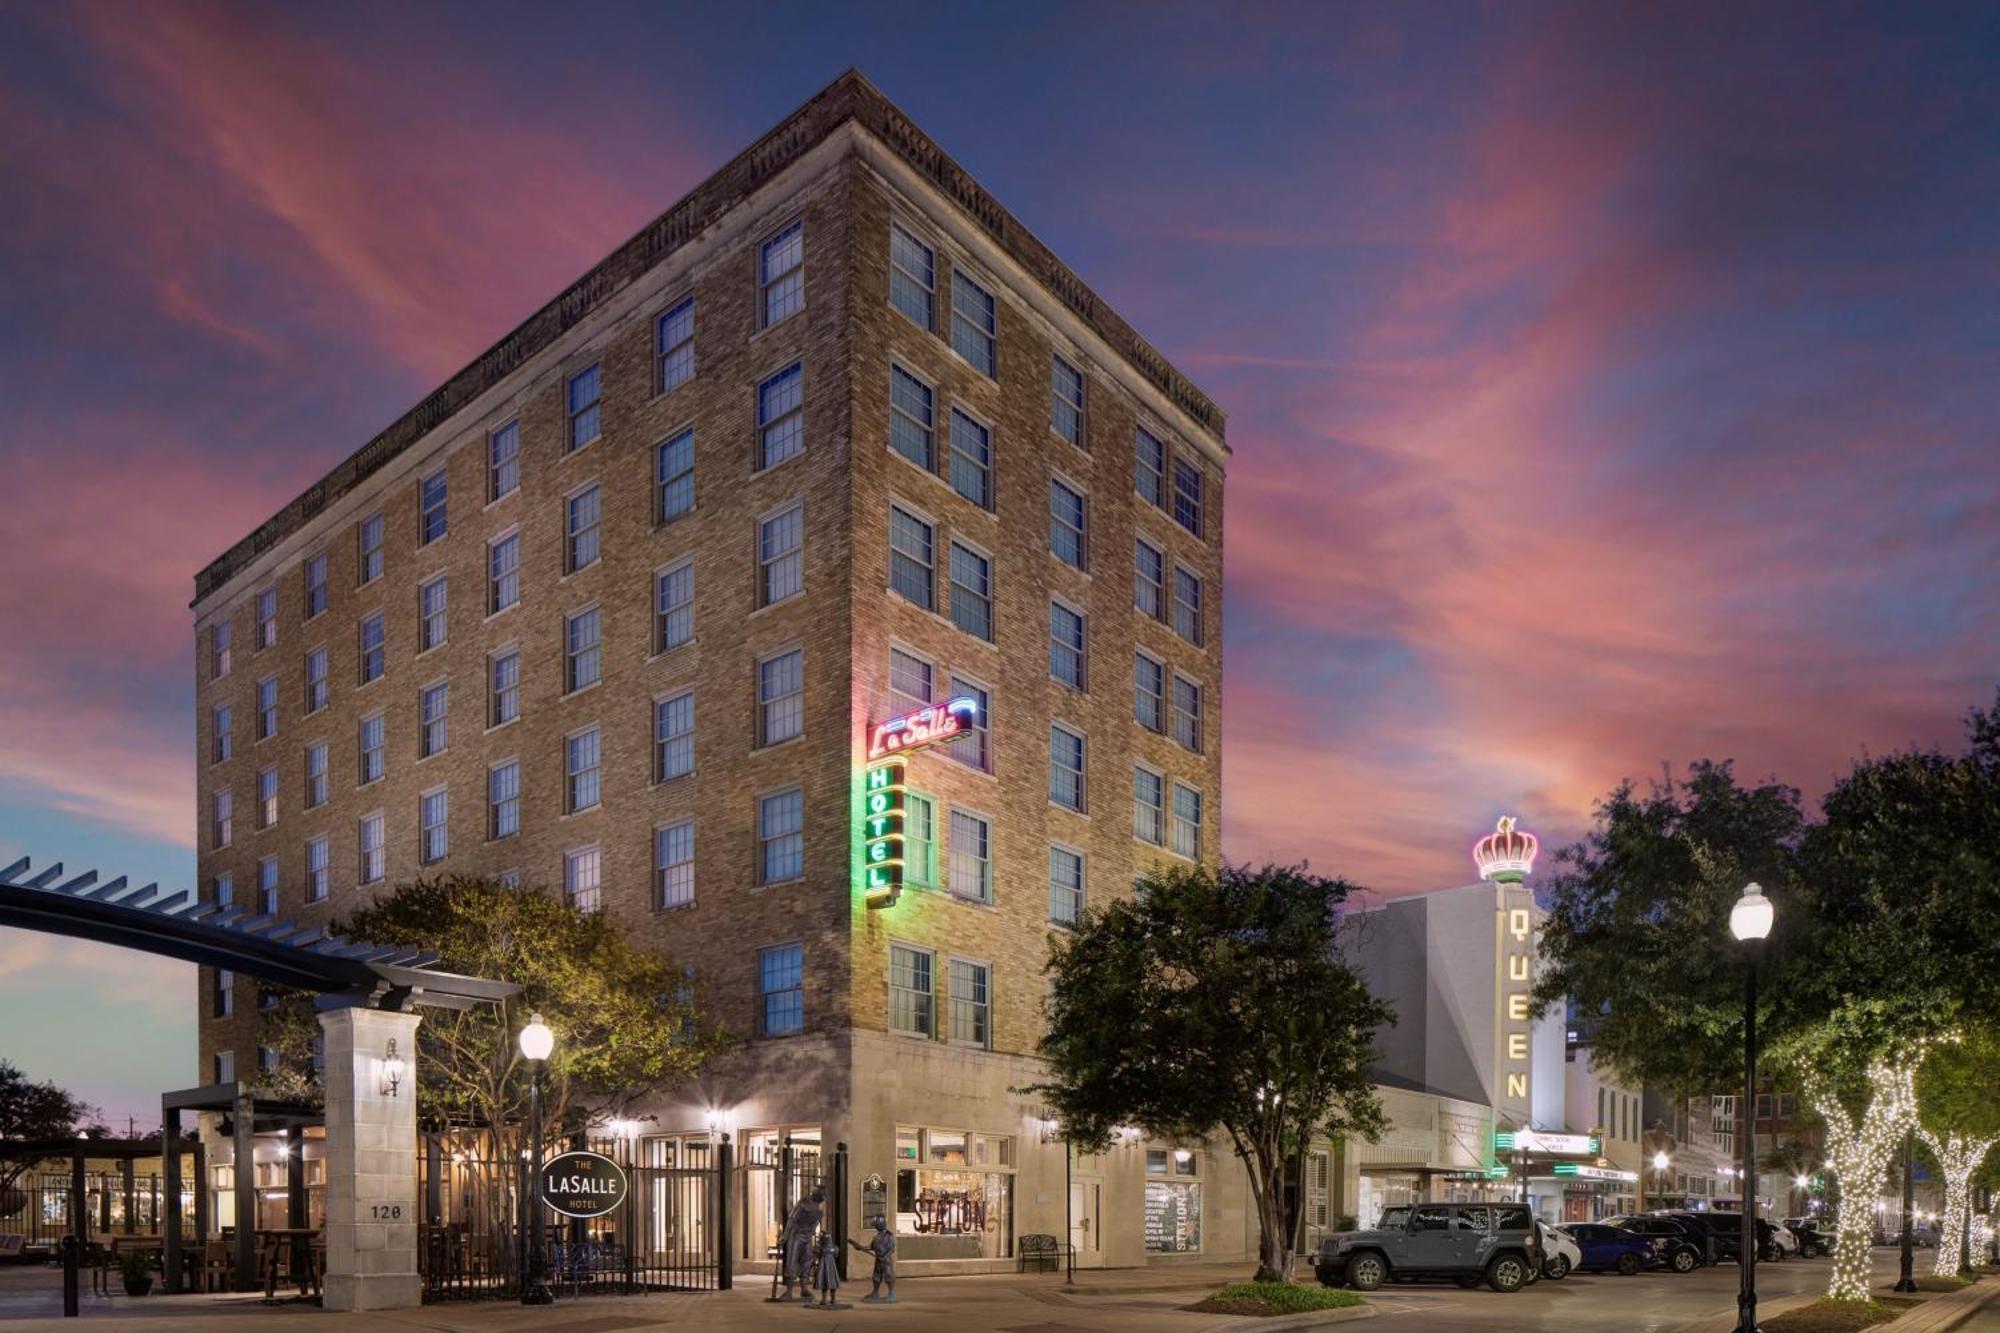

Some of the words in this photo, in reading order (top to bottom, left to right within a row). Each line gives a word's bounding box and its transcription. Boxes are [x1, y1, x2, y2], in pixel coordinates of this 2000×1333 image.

[869, 767, 888, 887] HOTEL
[1508, 909, 1529, 1098] QUEEN
[575, 1160, 592, 1169] THE
[569, 1200, 598, 1209] HOTEL
[913, 1198, 986, 1233] STATION
